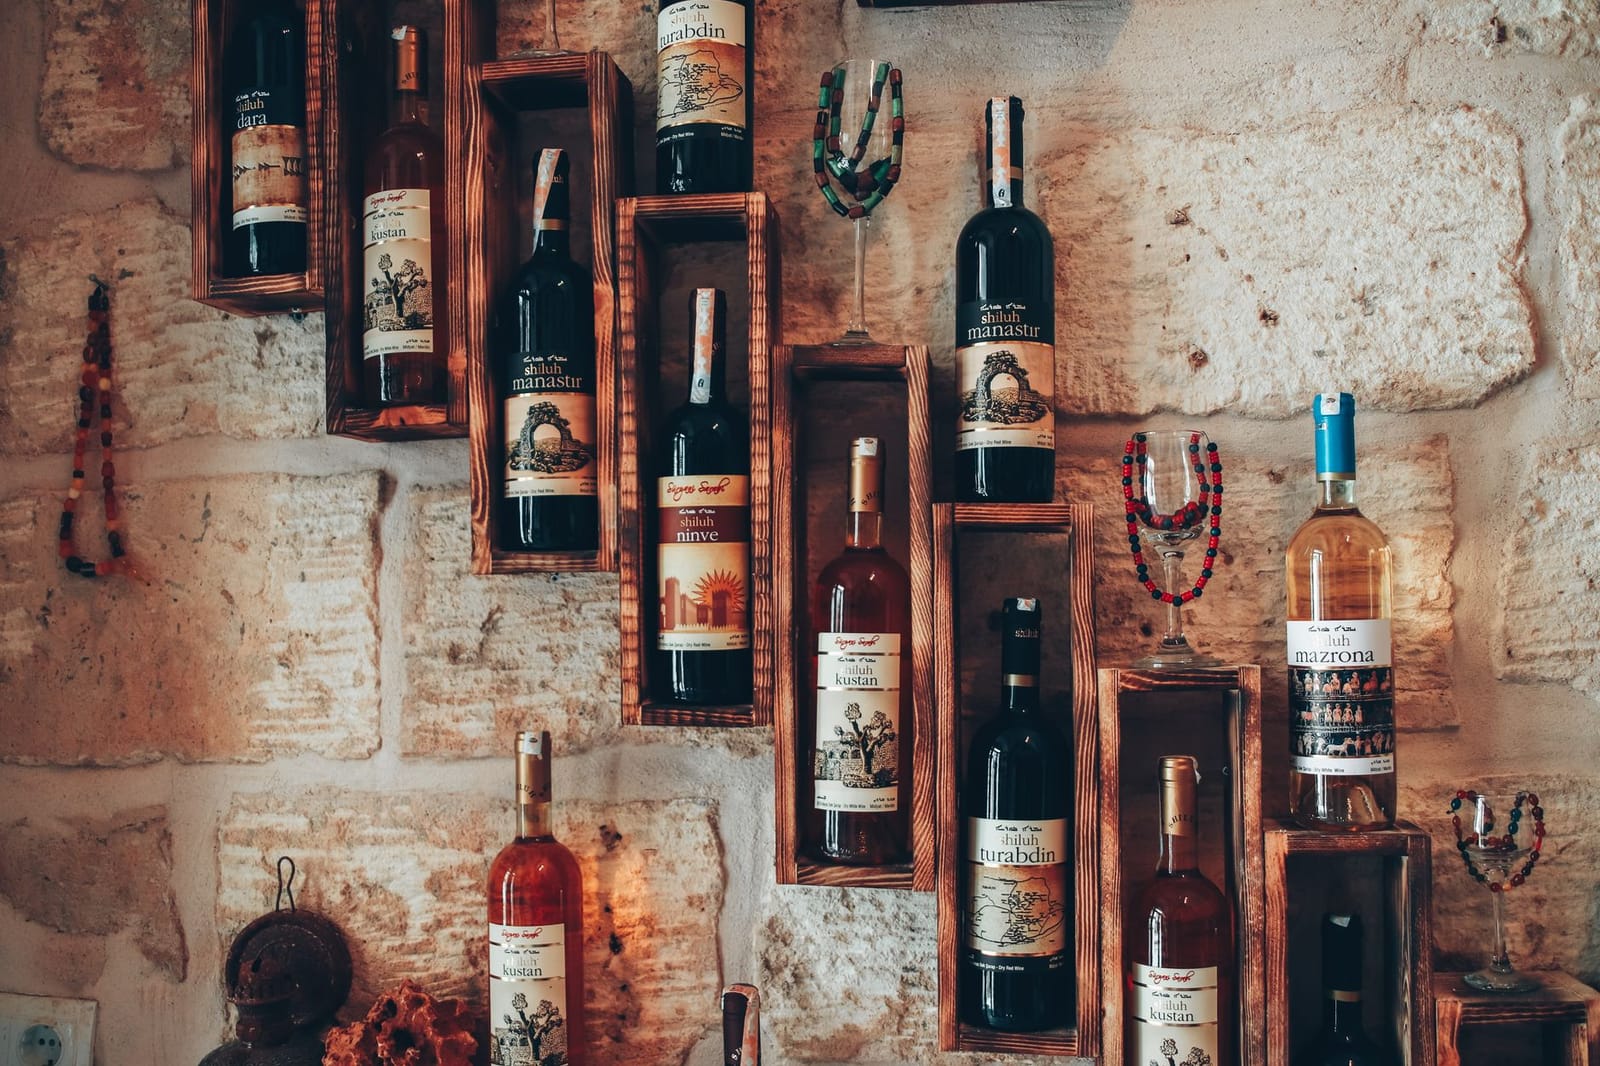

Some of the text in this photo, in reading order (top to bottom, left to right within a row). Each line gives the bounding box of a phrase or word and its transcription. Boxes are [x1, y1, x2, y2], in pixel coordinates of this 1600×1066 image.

[237, 113, 267, 129] dara
[371, 228, 406, 241] kustan
[981, 310, 1020, 324] shiluh
[524, 362, 562, 376] shiluh
[680, 515, 714, 527] shiluh
[677, 528, 719, 542] ninve
[1295, 650, 1375, 663] mazrona
[835, 673, 878, 686] kustan
[1000, 834, 1039, 846] shiluh
[980, 847, 1055, 863] turabdin
[503, 964, 542, 977] kustan
[1150, 1007, 1194, 1022] kustan
